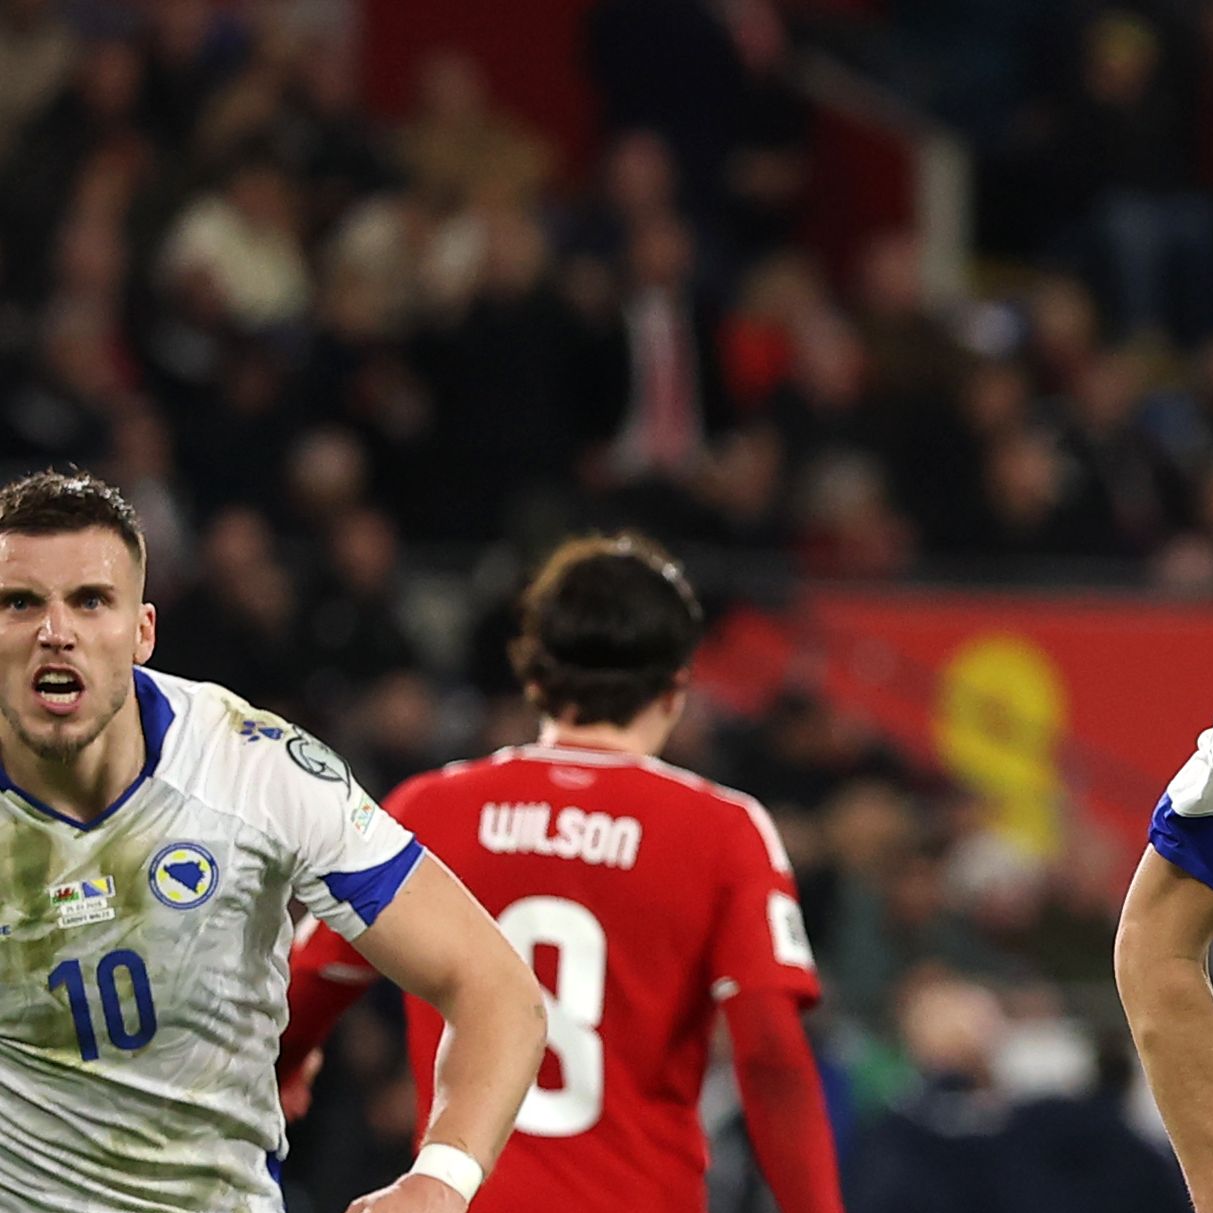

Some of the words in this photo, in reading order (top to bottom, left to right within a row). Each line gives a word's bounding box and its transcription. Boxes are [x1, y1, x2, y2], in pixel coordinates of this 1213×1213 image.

[479, 801, 642, 870] WILSON
[47, 948, 157, 1062] 10
[495, 895, 607, 1137] 8
